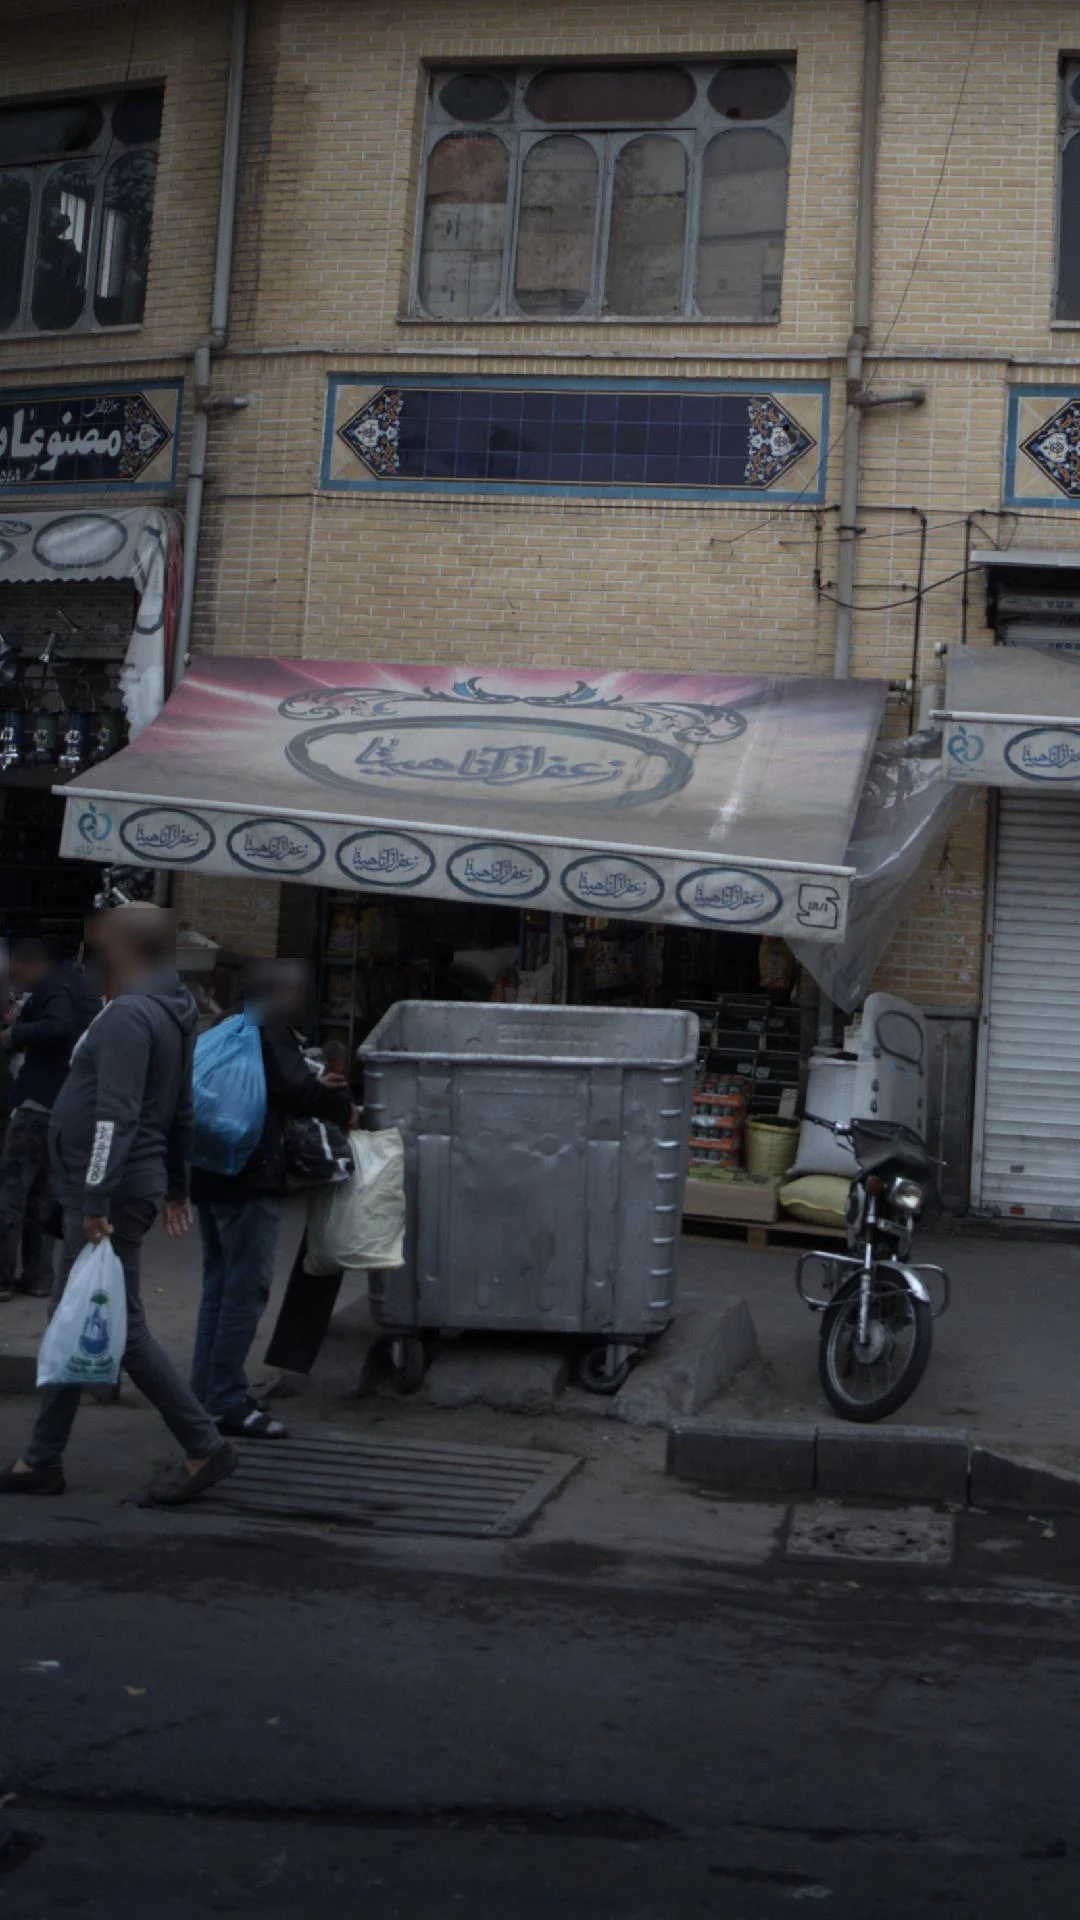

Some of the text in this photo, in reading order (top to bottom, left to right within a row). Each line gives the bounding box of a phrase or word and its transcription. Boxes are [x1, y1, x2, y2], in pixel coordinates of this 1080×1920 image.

[0, 407, 121, 471] مصنوعا
[355, 737, 627, 789] زعفران آناهیتا
